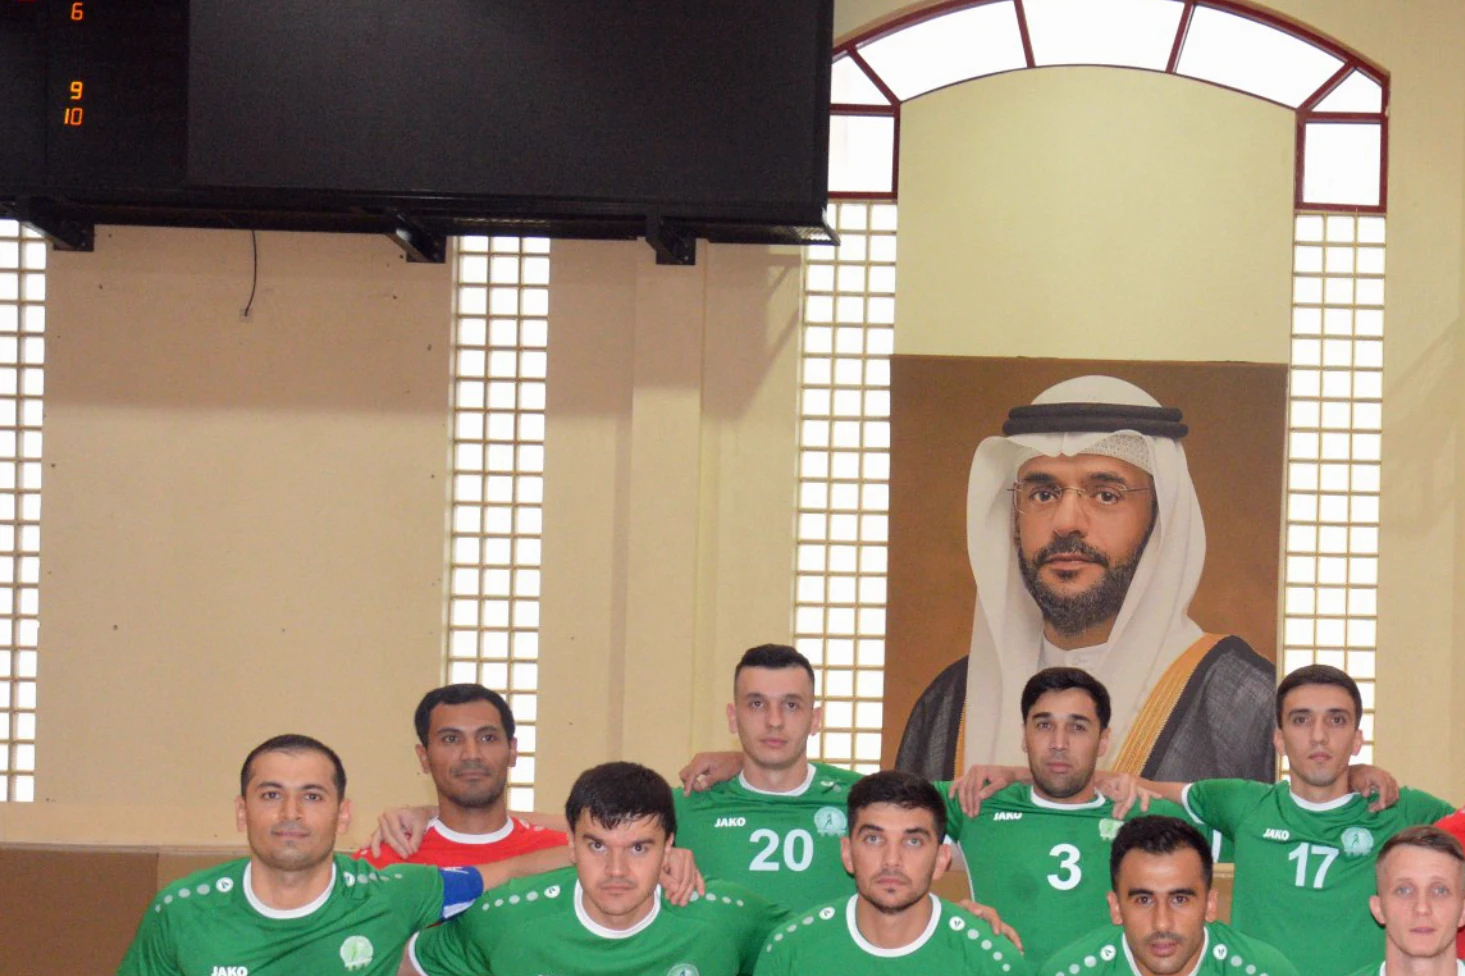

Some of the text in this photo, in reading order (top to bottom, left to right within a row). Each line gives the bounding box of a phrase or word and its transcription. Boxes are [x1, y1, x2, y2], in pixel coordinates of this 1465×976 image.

[71, 2, 83, 20] 6
[70, 81, 83, 99] 9
[64, 107, 83, 126] 10
[715, 817, 746, 827] JAKO
[1263, 828, 1290, 840] JAKO
[749, 829, 813, 871] 20
[1047, 844, 1081, 890] 3
[1288, 843, 1339, 888] 17
